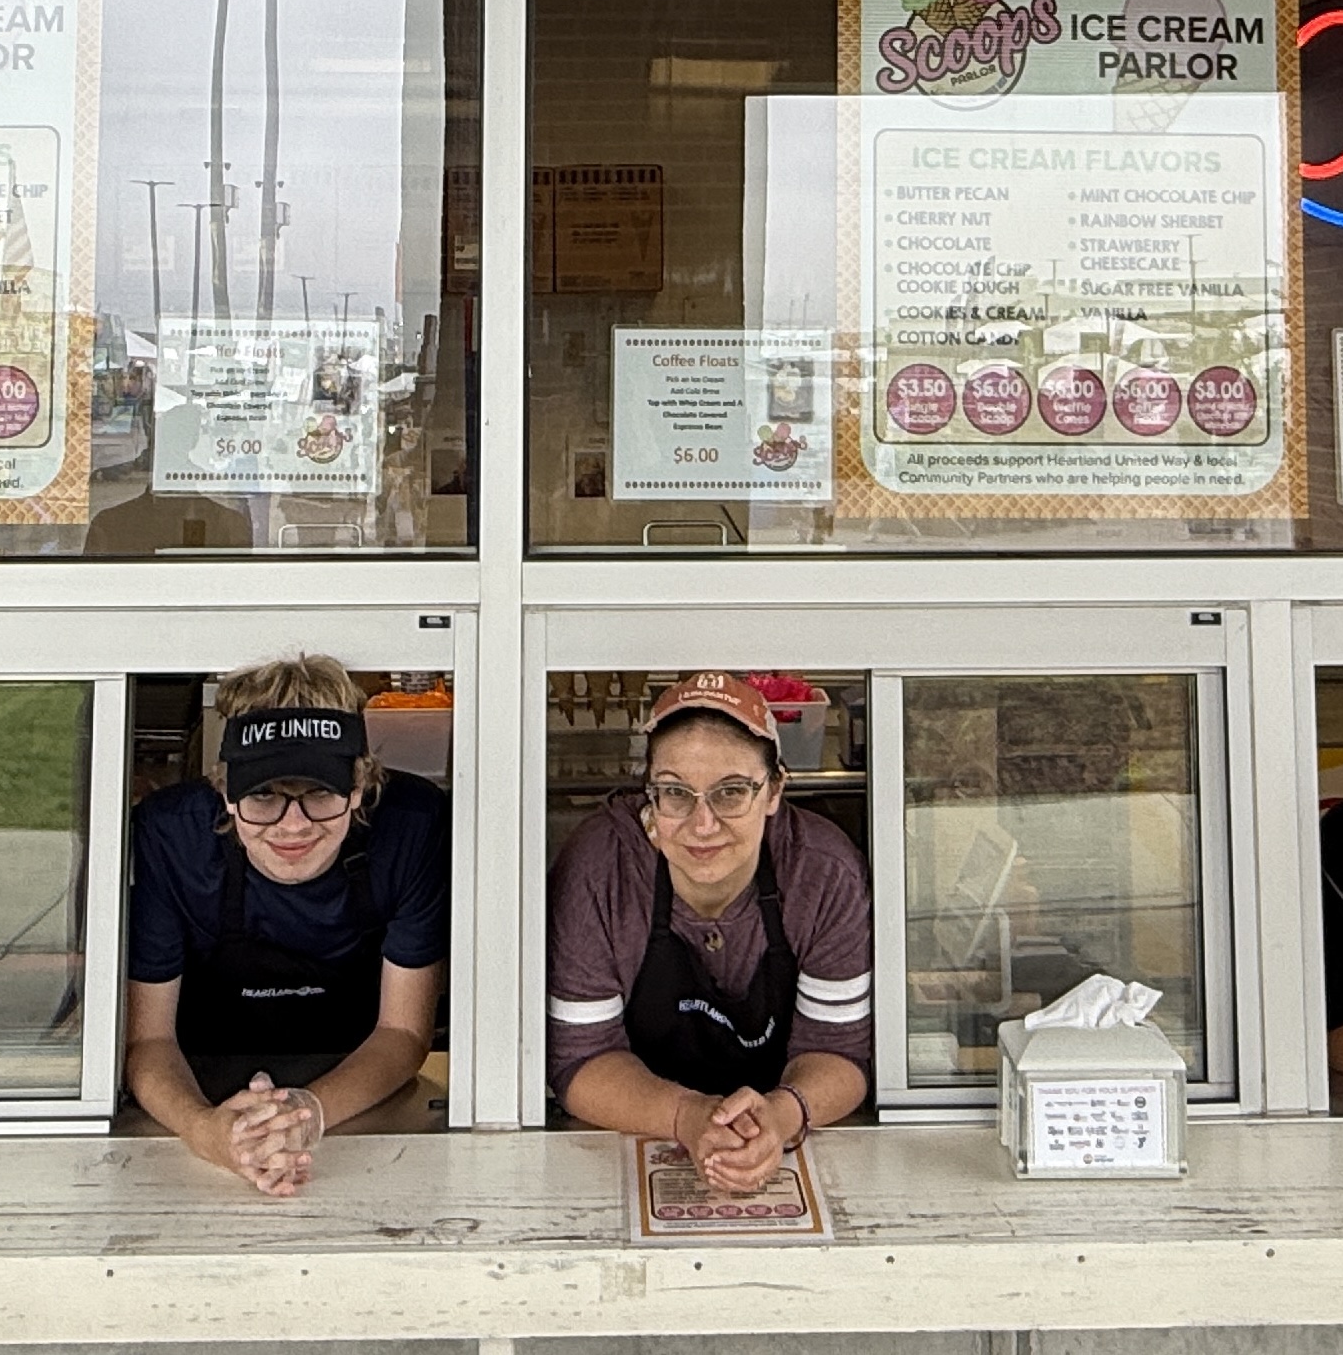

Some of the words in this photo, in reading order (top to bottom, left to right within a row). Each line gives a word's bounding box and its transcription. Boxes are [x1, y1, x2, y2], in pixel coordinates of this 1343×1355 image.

[1071, 14, 1126, 41] ICE
[1137, 15, 1264, 44] CREAM
[1098, 52, 1237, 80] PARLOR
[950, 64, 997, 85] PARLOR
[912, 146, 962, 169] ICE
[969, 147, 1076, 171] CREAM
[1085, 149, 1221, 173] FLAVORS
[12, 184, 48, 199] CHIP
[897, 186, 950, 201] BUTTER
[955, 186, 1009, 201] PECAN
[1080, 189, 1119, 204] MINT
[1123, 189, 1221, 204] CHOCOLATE
[1225, 189, 1256, 204] CHIP
[897, 212, 956, 226] CHERRY
[961, 212, 991, 226] NUT
[1080, 214, 1158, 229] RAINBOW
[1161, 214, 1223, 229] SHERBET
[896, 236, 991, 251] CHOCOLATE
[1080, 239, 1179, 254] STRAWBERRY
[897, 262, 993, 277] CHOCOLATE
[997, 263, 1031, 277] CHIP
[1080, 256, 1180, 271] CHEESECAKE
[896, 280, 958, 295] COOKIE
[962, 280, 1020, 295] DOUGH
[1080, 282, 1134, 297] SUGAR
[1138, 282, 1174, 297] FREE
[1178, 282, 1244, 297] VANILLA
[897, 306, 967, 321] COOKIES
[971, 306, 982, 321] &
[986, 306, 1045, 321] CREAM
[1080, 306, 1147, 321] VANILLA
[897, 331, 959, 345] COTTON
[653, 354, 695, 367] Coffee
[700, 354, 739, 367] Floats
[898, 379, 946, 397] $3.50
[973, 379, 1021, 399] $6.00
[1195, 381, 1243, 399] $3.00
[216, 438, 262, 456] $6.00
[673, 446, 719, 464] $6.00
[907, 453, 924, 466] All
[928, 454, 989, 468] proceeds
[993, 454, 1043, 468] support
[1115, 454, 1158, 466] United
[1162, 454, 1190, 468] Way
[1194, 454, 1202, 466] &
[899, 472, 973, 486] Community
[977, 472, 1032, 484] Partners
[1035, 473, 1064, 484] who
[1067, 474, 1088, 484] are
[1092, 472, 1141, 486] helping
[1145, 473, 1190, 486] people
[241, 722, 277, 746] LIVE
[281, 718, 341, 740] UNITED
